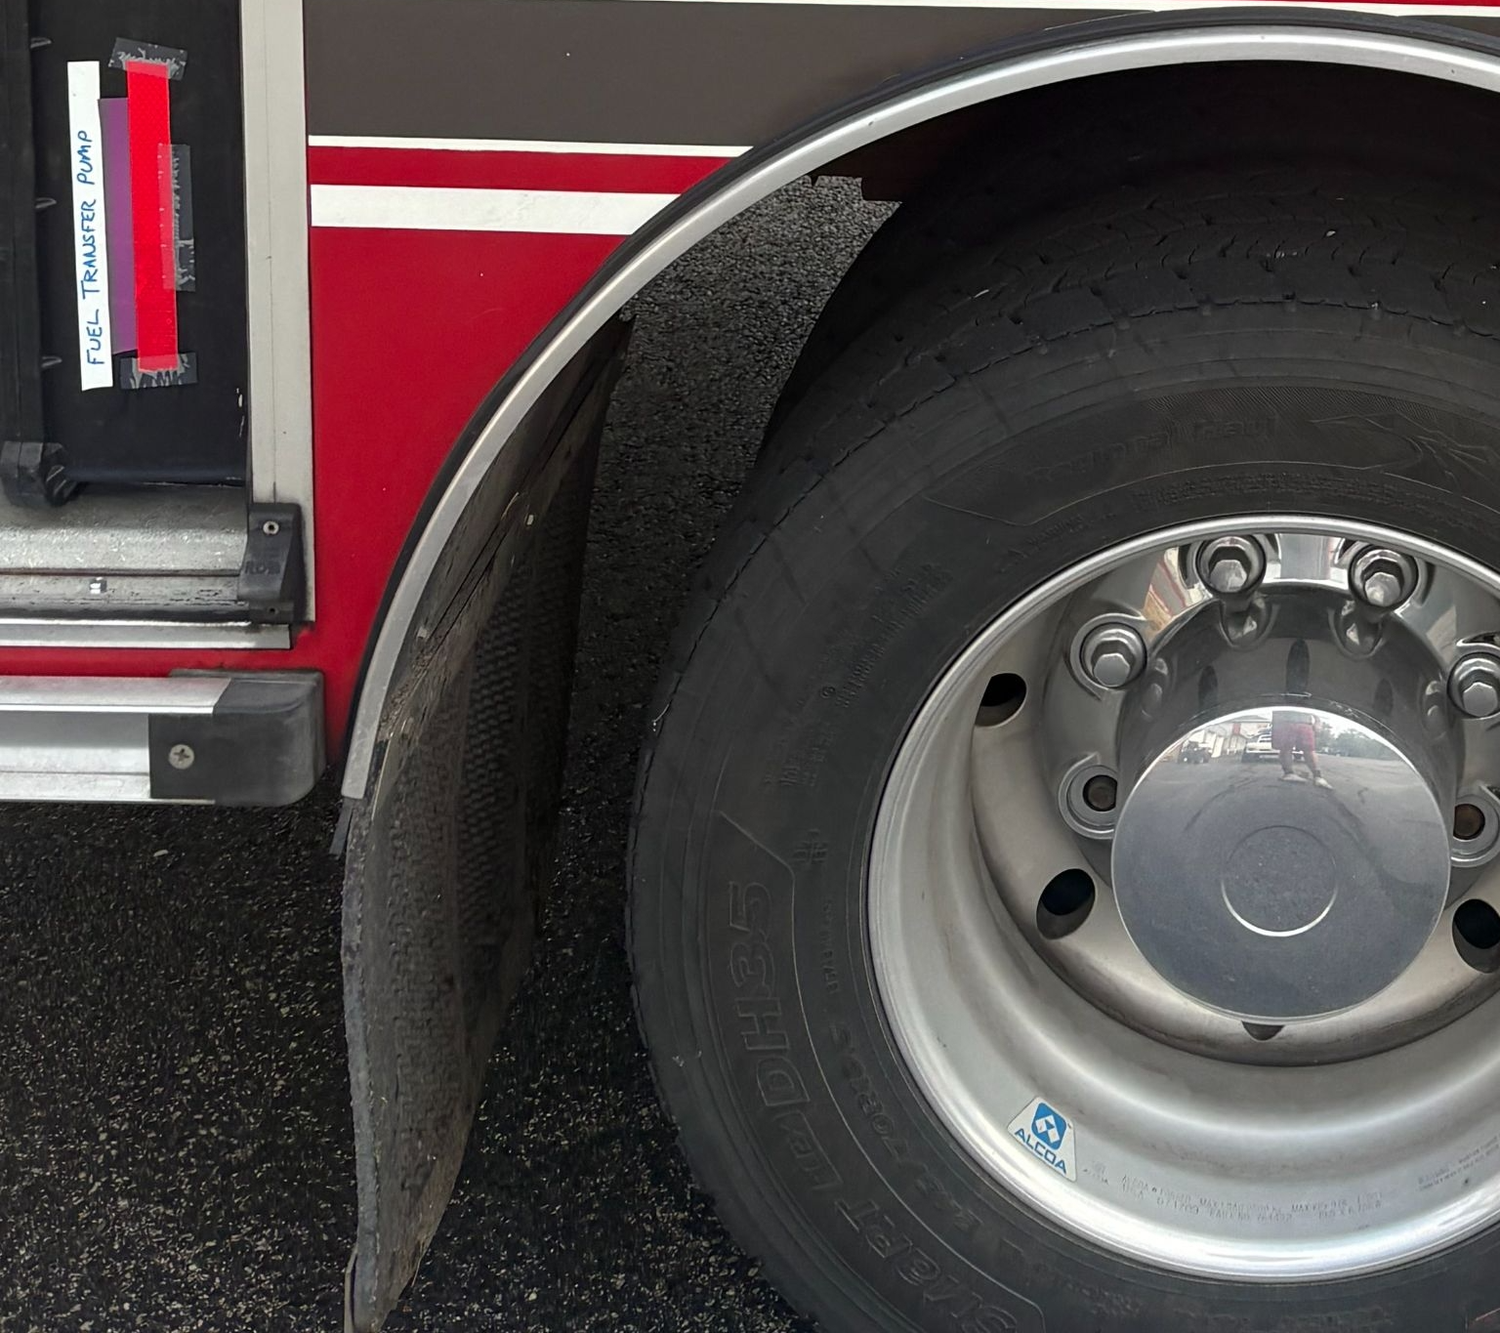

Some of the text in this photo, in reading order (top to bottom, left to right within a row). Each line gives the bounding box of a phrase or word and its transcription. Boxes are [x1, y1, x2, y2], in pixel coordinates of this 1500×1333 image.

[75, 129, 105, 366] FUEL TRANSFER PUMP
[1014, 1127, 1067, 1175] ALCOA
